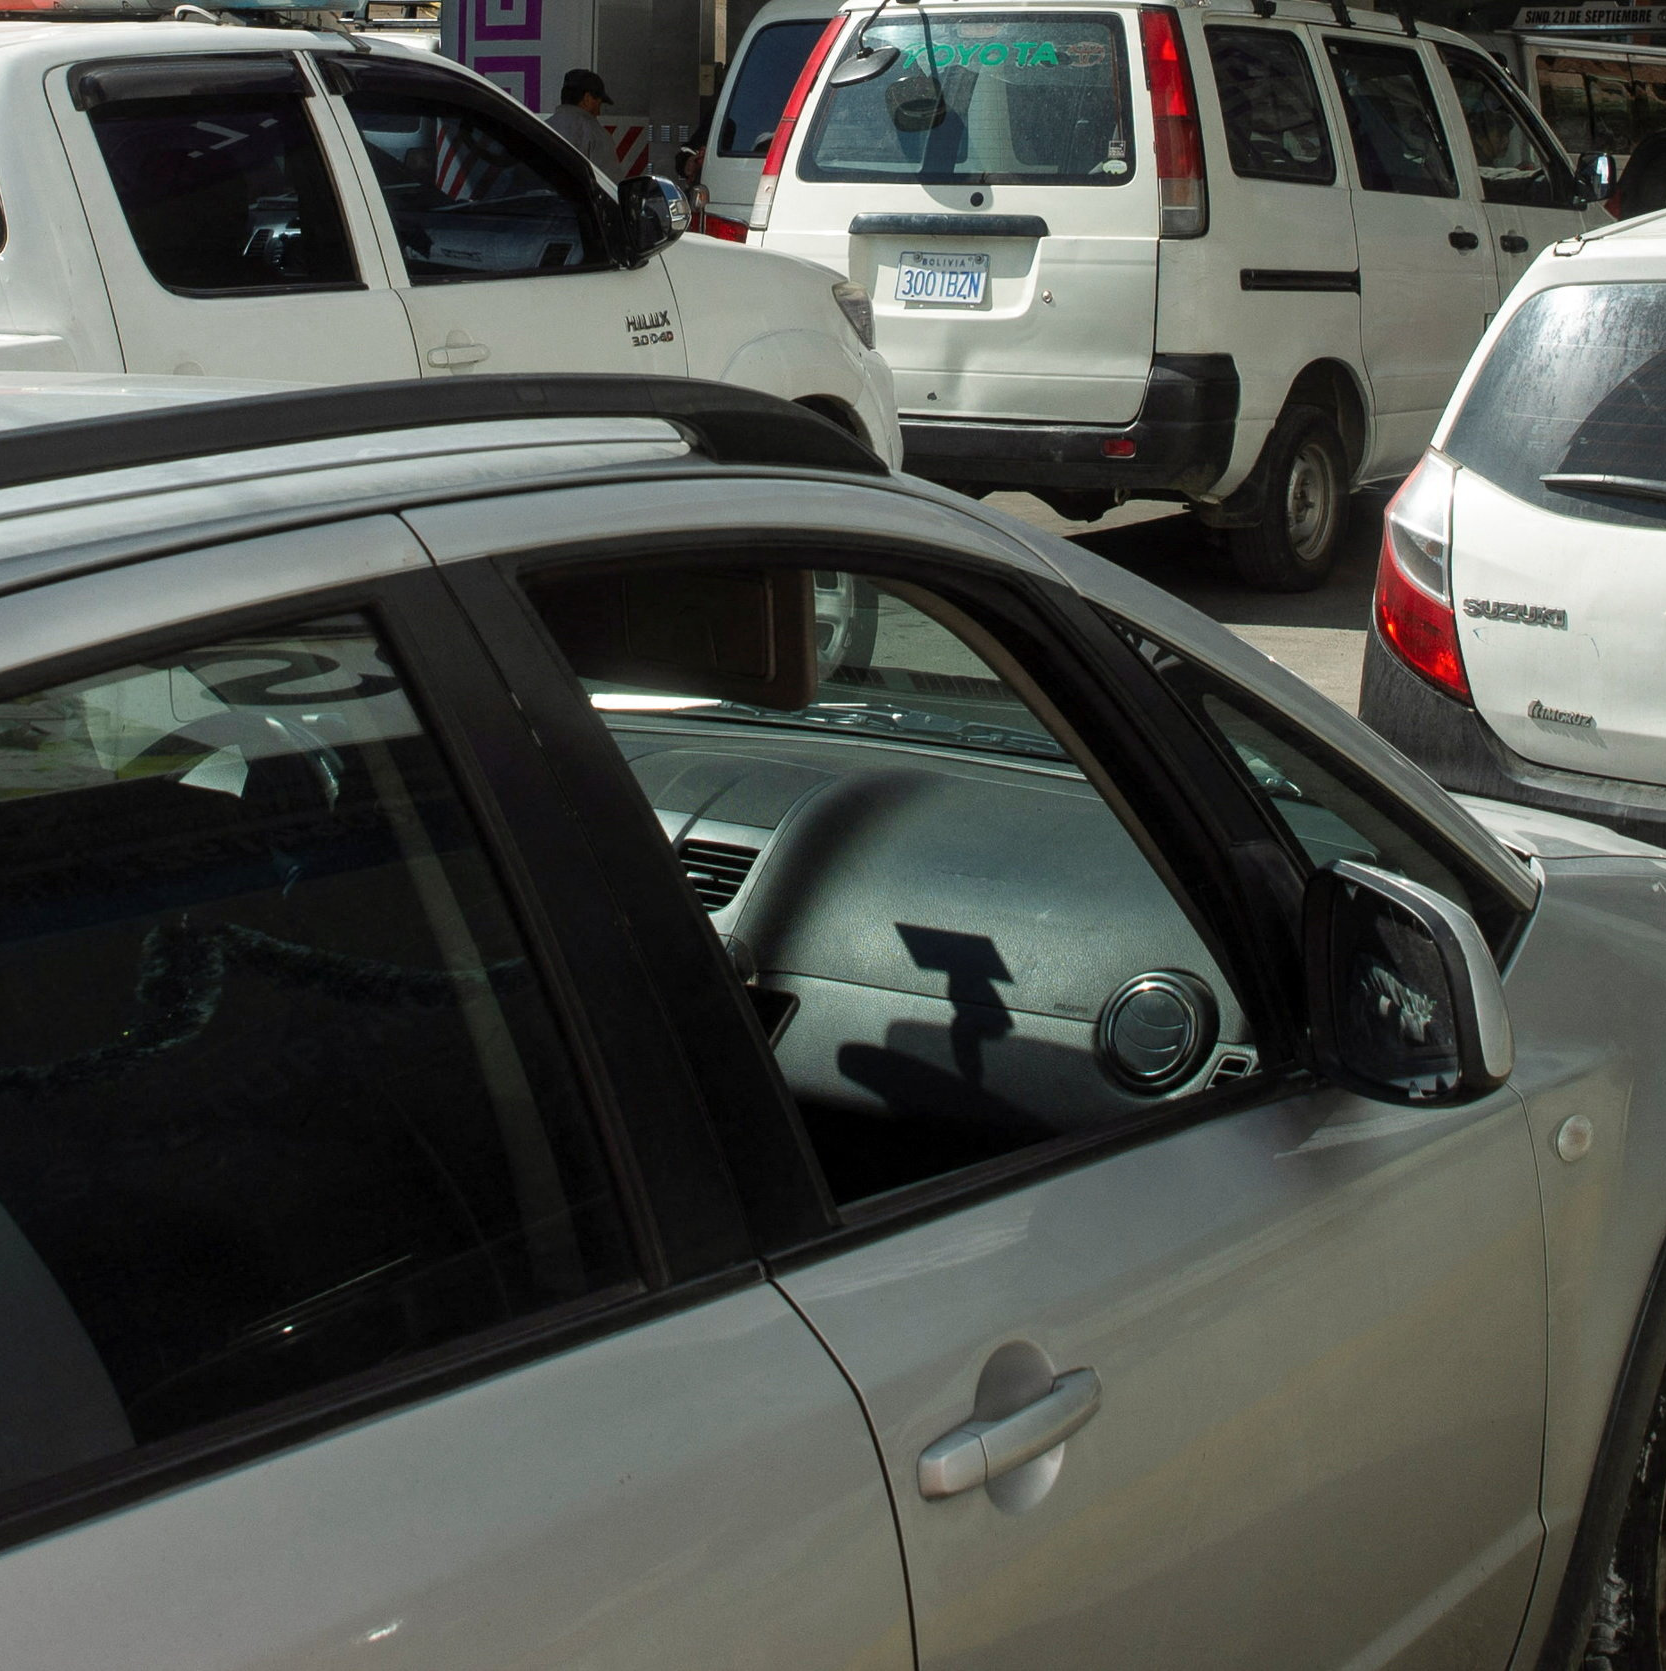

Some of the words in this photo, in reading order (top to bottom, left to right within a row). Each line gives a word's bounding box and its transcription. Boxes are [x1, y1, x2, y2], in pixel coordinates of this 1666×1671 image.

[1553, 11, 1566, 24] 21
[1568, 10, 1581, 24] DE
[1584, 9, 1652, 24] SEPTIEMBRE
[902, 41, 1059, 69] TOYOTA
[922, 258, 966, 267] BOLIVIA
[901, 269, 981, 298] 3001BZN
[625, 310, 671, 332] HILUX
[1463, 597, 1567, 629] SUZUKI
